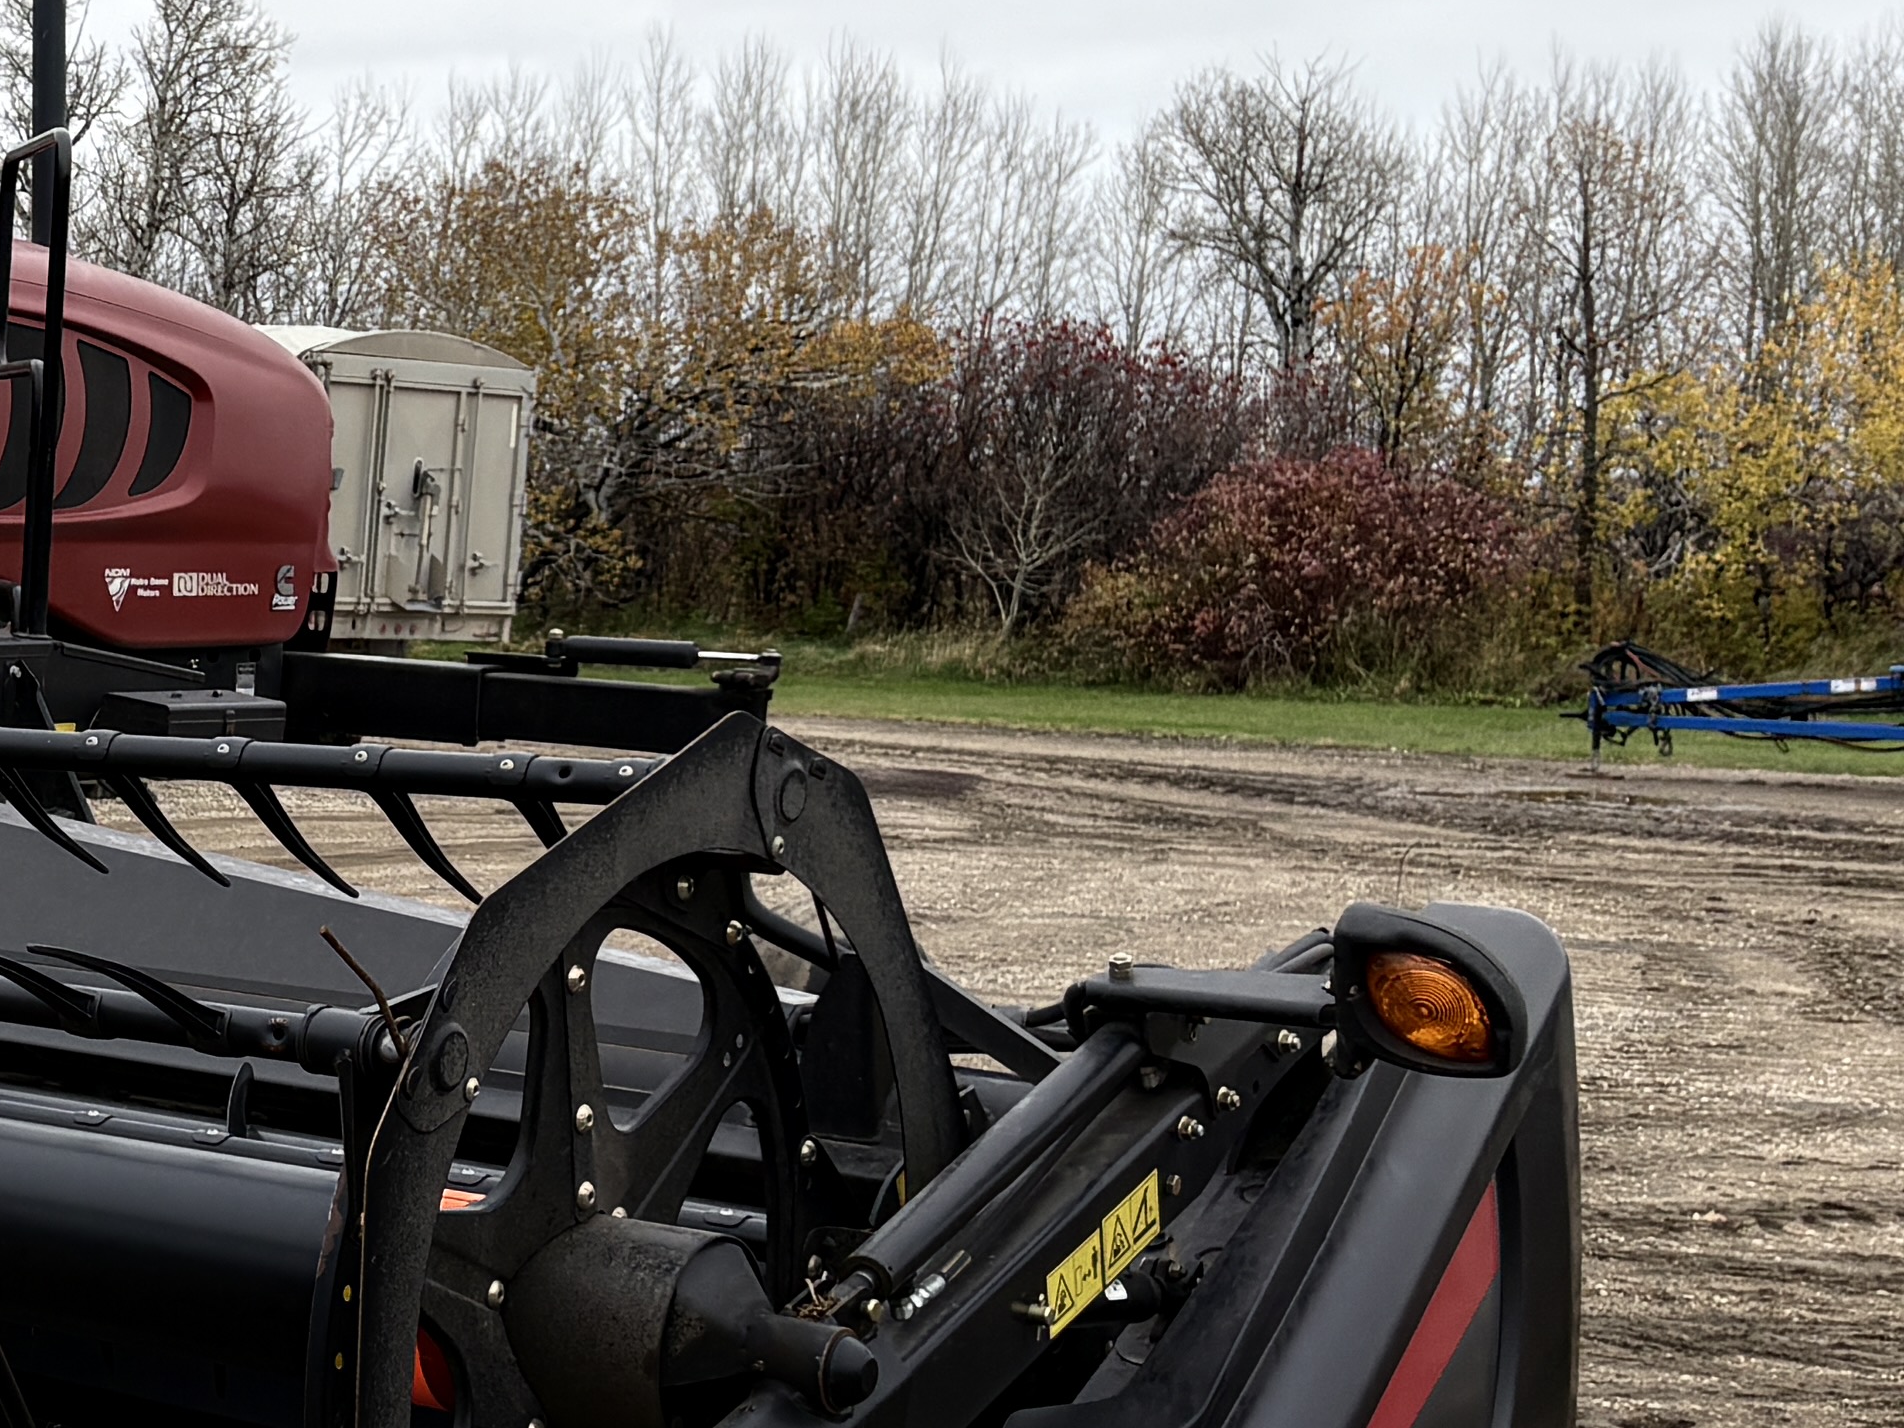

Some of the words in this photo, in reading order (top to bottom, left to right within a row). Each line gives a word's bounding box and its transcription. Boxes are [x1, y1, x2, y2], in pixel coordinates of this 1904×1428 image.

[104, 568, 130, 577] NDM
[198, 572, 229, 584] DUAL
[198, 583, 259, 596] DIRECTION
